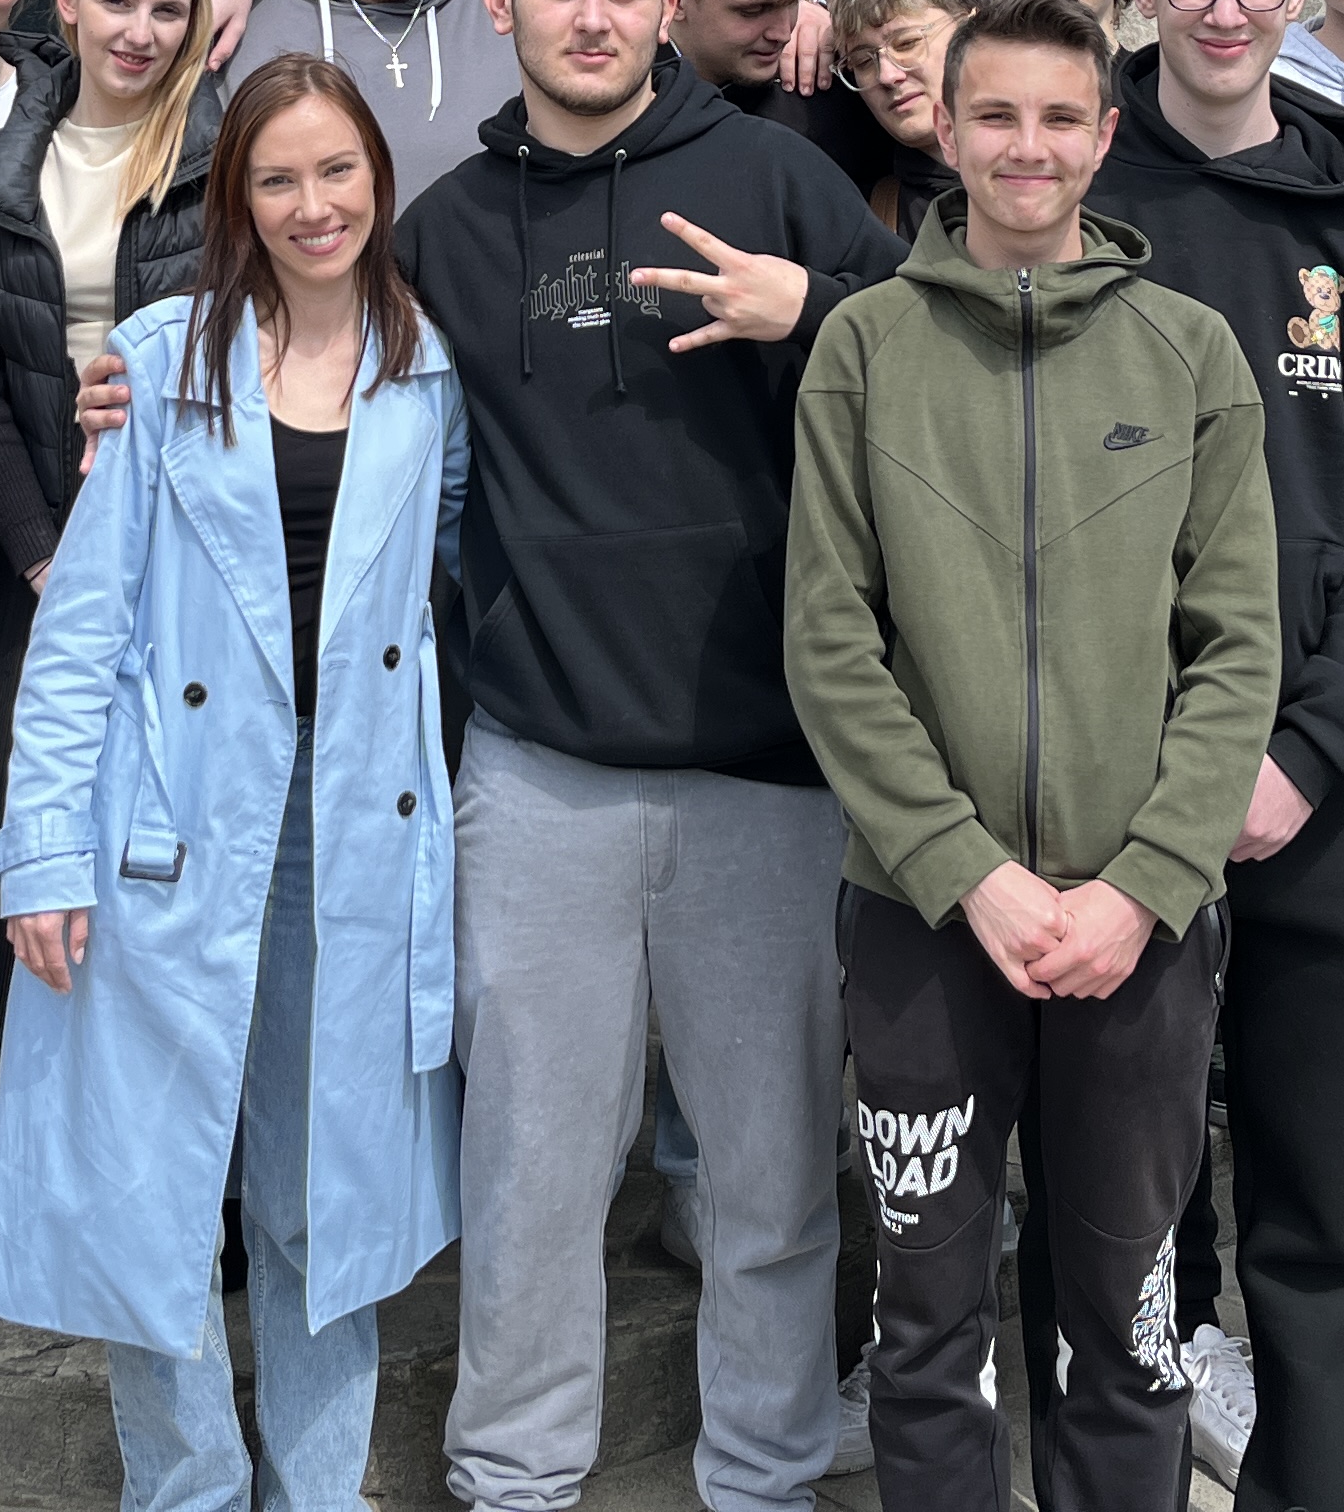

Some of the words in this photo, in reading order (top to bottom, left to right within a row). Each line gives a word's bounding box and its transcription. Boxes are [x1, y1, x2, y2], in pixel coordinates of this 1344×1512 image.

[1112, 422, 1149, 443] NIKE
[857, 1094, 974, 1155] DOWN
[864, 1144, 959, 1198] LOAD
